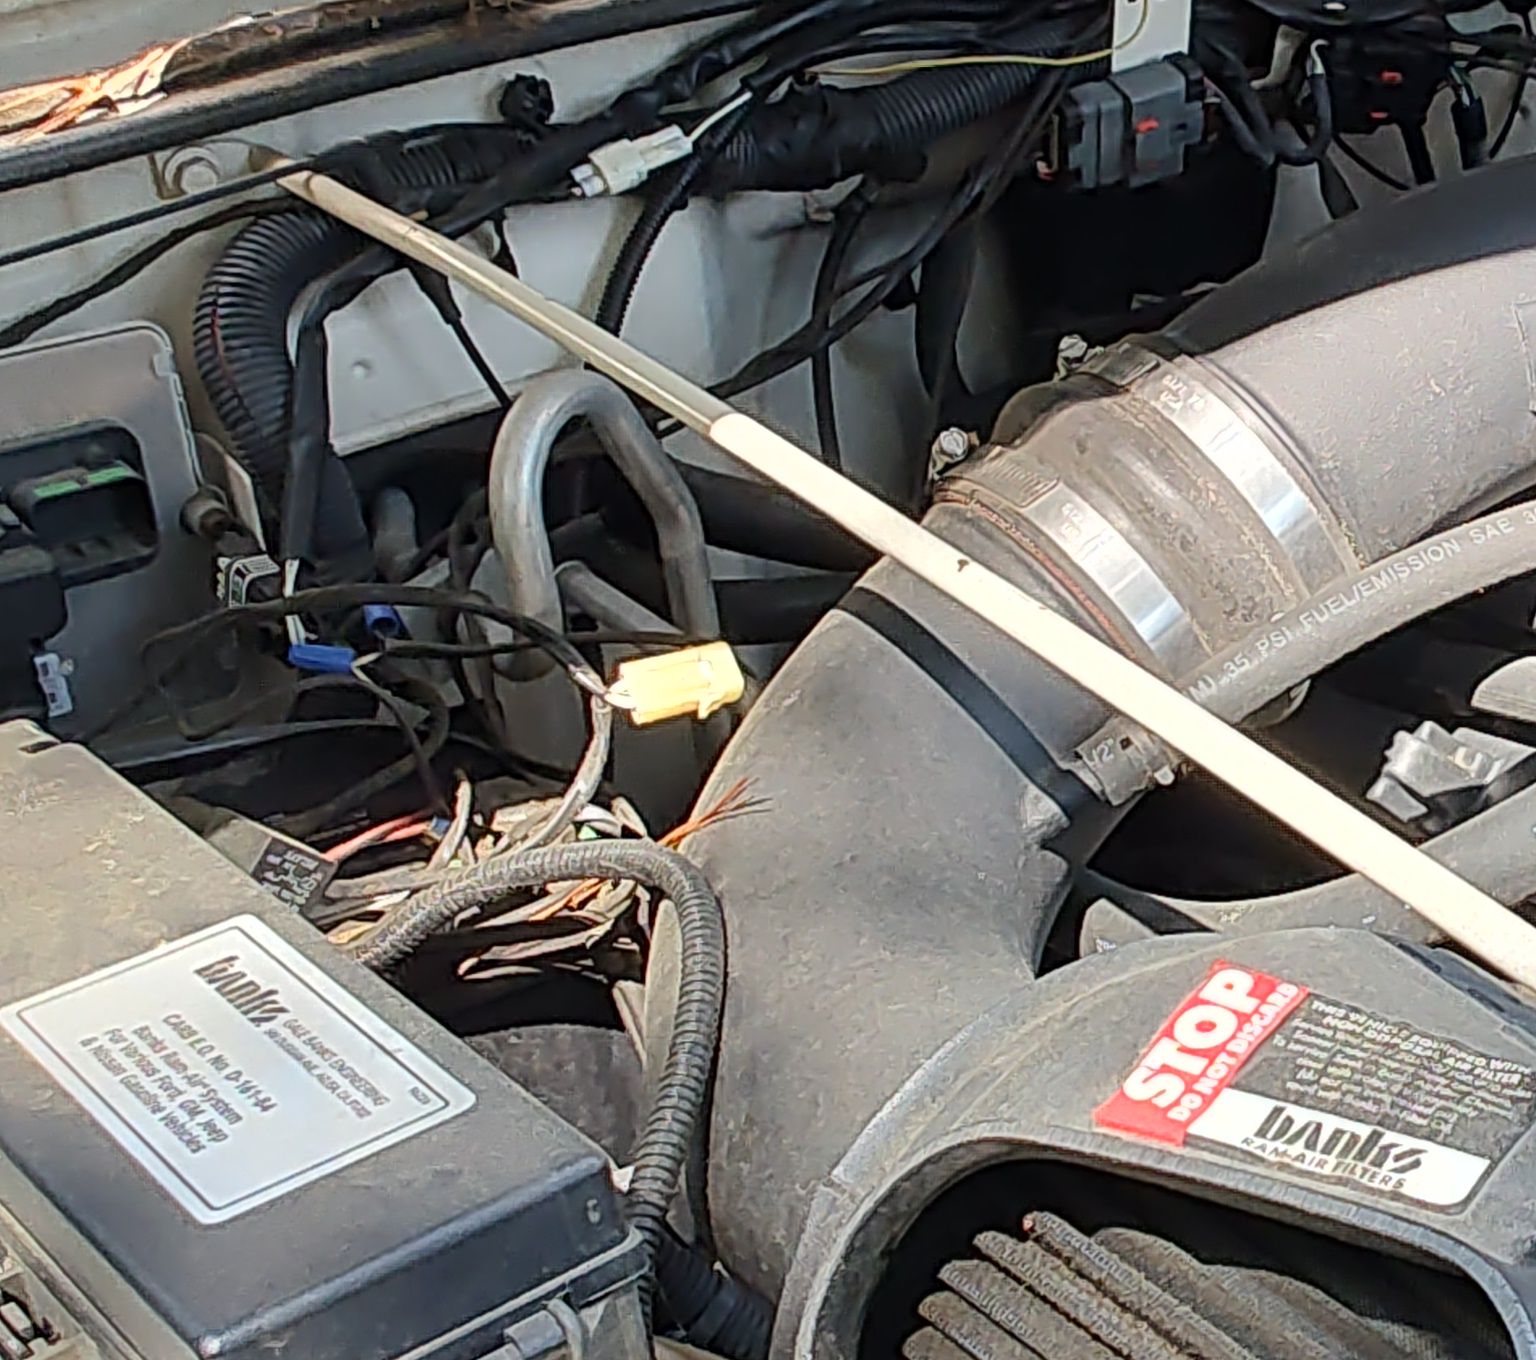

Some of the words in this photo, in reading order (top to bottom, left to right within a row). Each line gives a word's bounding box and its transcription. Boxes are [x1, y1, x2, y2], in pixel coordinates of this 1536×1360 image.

[1255, 624, 1294, 657] PSI
[1300, 539, 1461, 634] FUEL/EMISSION
[1469, 514, 1515, 544] SAE
[103, 1027, 127, 1046] For
[118, 1042, 162, 1079] Various
[197, 1118, 229, 1146] Jeep
[130, 1023, 168, 1055] Banks
[198, 1085, 244, 1127] System
[1123, 968, 1261, 1108] STOP
[1167, 1093, 1203, 1122] DO
[1192, 1052, 1237, 1095] NOT
[1225, 982, 1299, 1054] DISCARD
[87, 1044, 126, 1078] Nissan
[118, 1073, 167, 1117] Gasoline
[157, 1111, 207, 1155] Vehicles
[1253, 1105, 1428, 1174] banks
[1241, 1137, 1326, 1171] RAM-AIR
[1331, 1160, 1406, 1189] FILTERS
